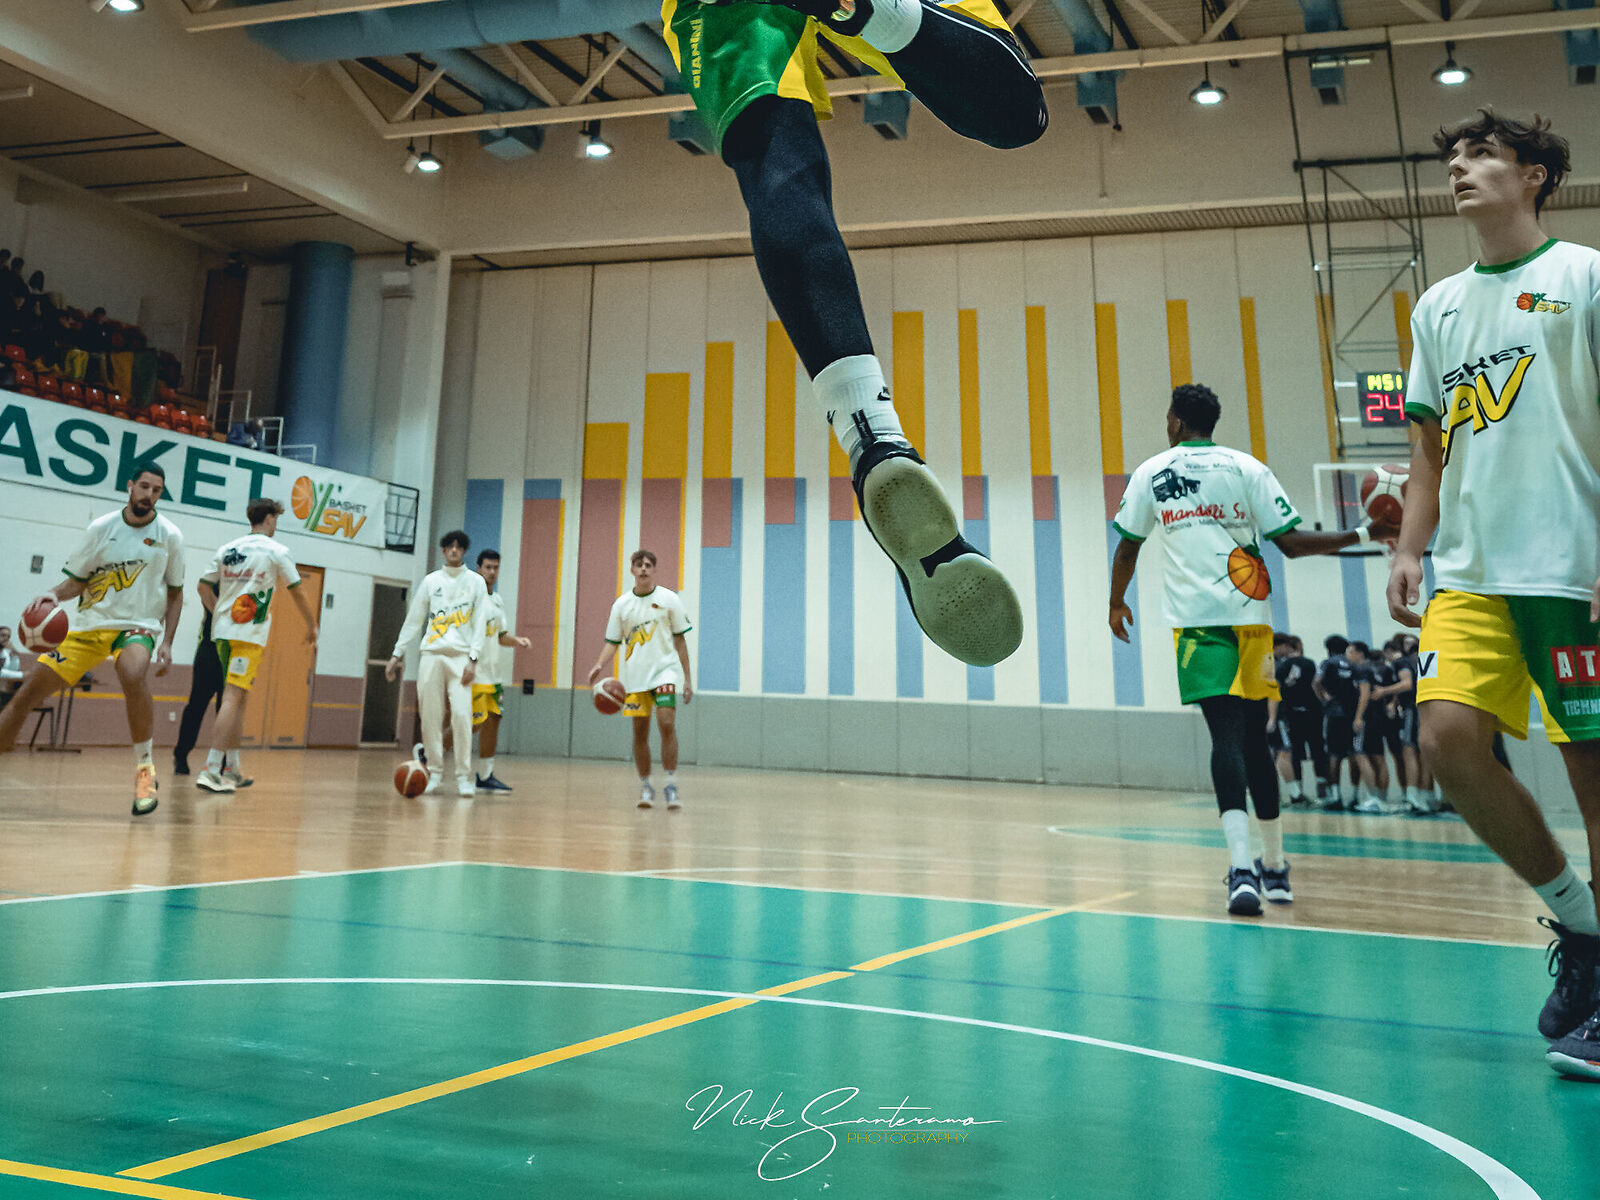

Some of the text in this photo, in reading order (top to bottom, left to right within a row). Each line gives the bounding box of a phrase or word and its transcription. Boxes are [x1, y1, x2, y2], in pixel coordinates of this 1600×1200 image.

[1442, 345, 1531, 393] SKET
[1365, 393, 1405, 422] 24
[1275, 496, 1292, 517] 3
[315, 508, 367, 539] SAV
